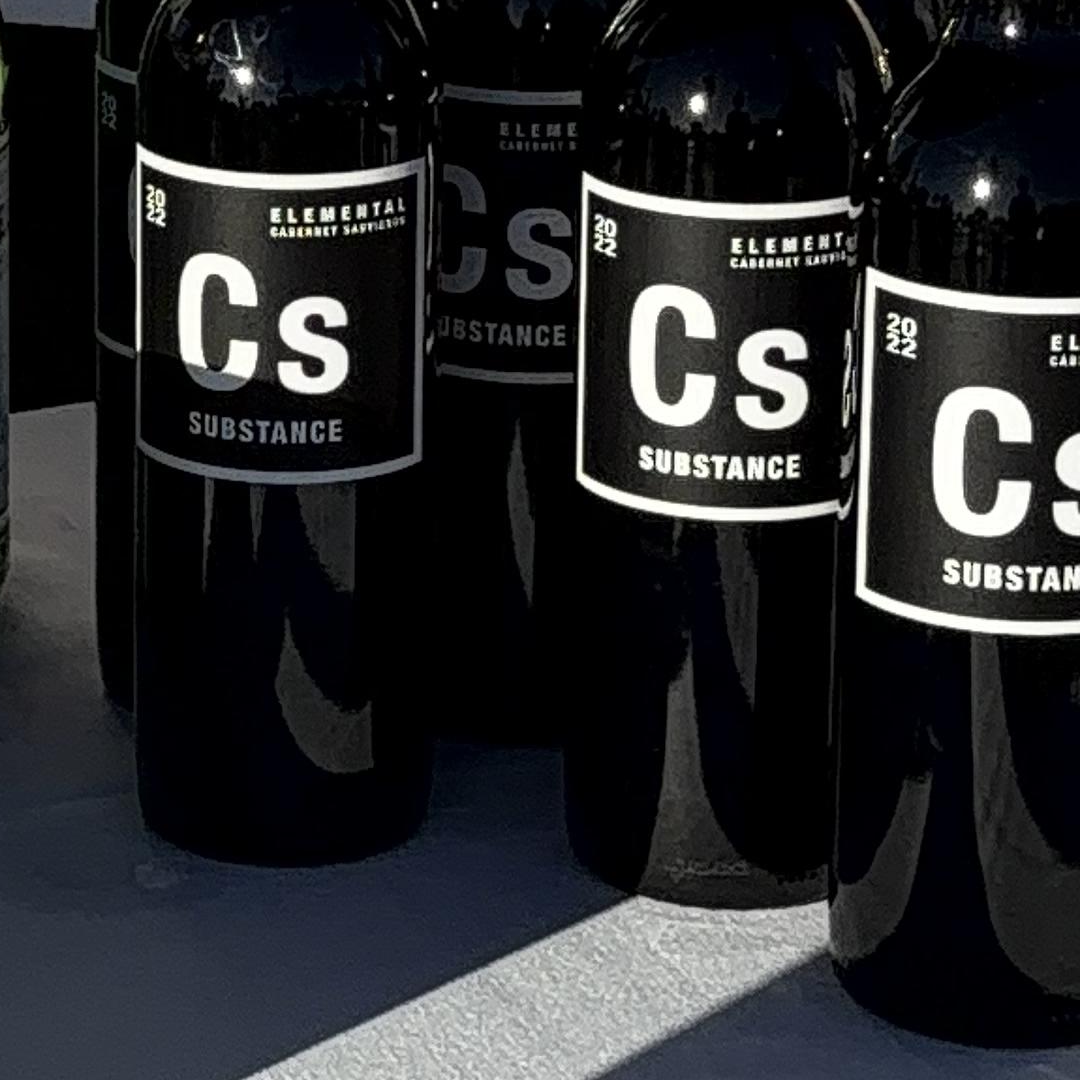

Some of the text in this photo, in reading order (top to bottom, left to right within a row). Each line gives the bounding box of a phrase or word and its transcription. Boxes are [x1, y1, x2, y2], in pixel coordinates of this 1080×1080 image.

[500, 122, 577, 138] ELEME
[270, 197, 406, 224] ELEMENTAL
[270, 225, 338, 239] CABERNET
[731, 232, 844, 255] ELEMENT
[729, 255, 801, 269] CABERNET
[177, 249, 350, 395] Cs
[437, 315, 568, 348] UBSTANCE
[628, 283, 809, 431] Cs
[189, 411, 342, 445] SUBSTANCE
[638, 444, 802, 481] SUBSTANCE
[942, 557, 1080, 593] SUBSTAN
